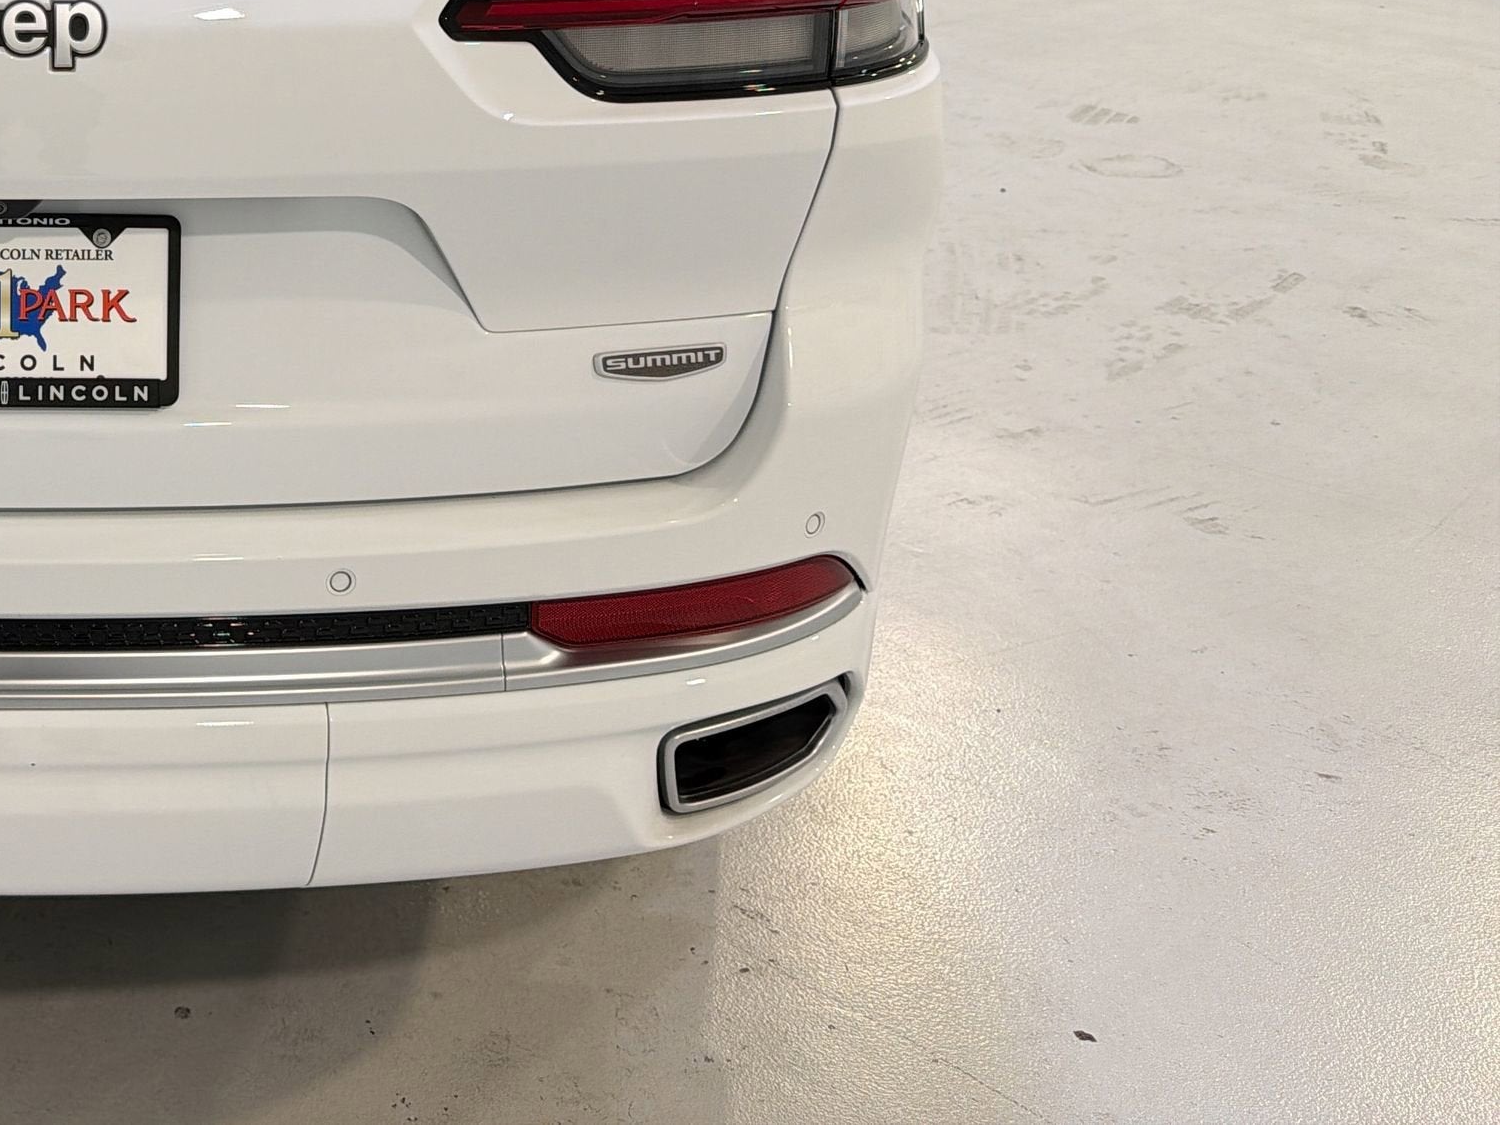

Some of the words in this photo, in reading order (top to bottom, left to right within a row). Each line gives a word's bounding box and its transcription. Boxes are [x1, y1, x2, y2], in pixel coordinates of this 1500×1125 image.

[44, 249, 114, 261] RETAILER
[18, 288, 137, 323] PARK
[606, 350, 721, 371] SUMMIT
[18, 384, 149, 402] LINCOLN
